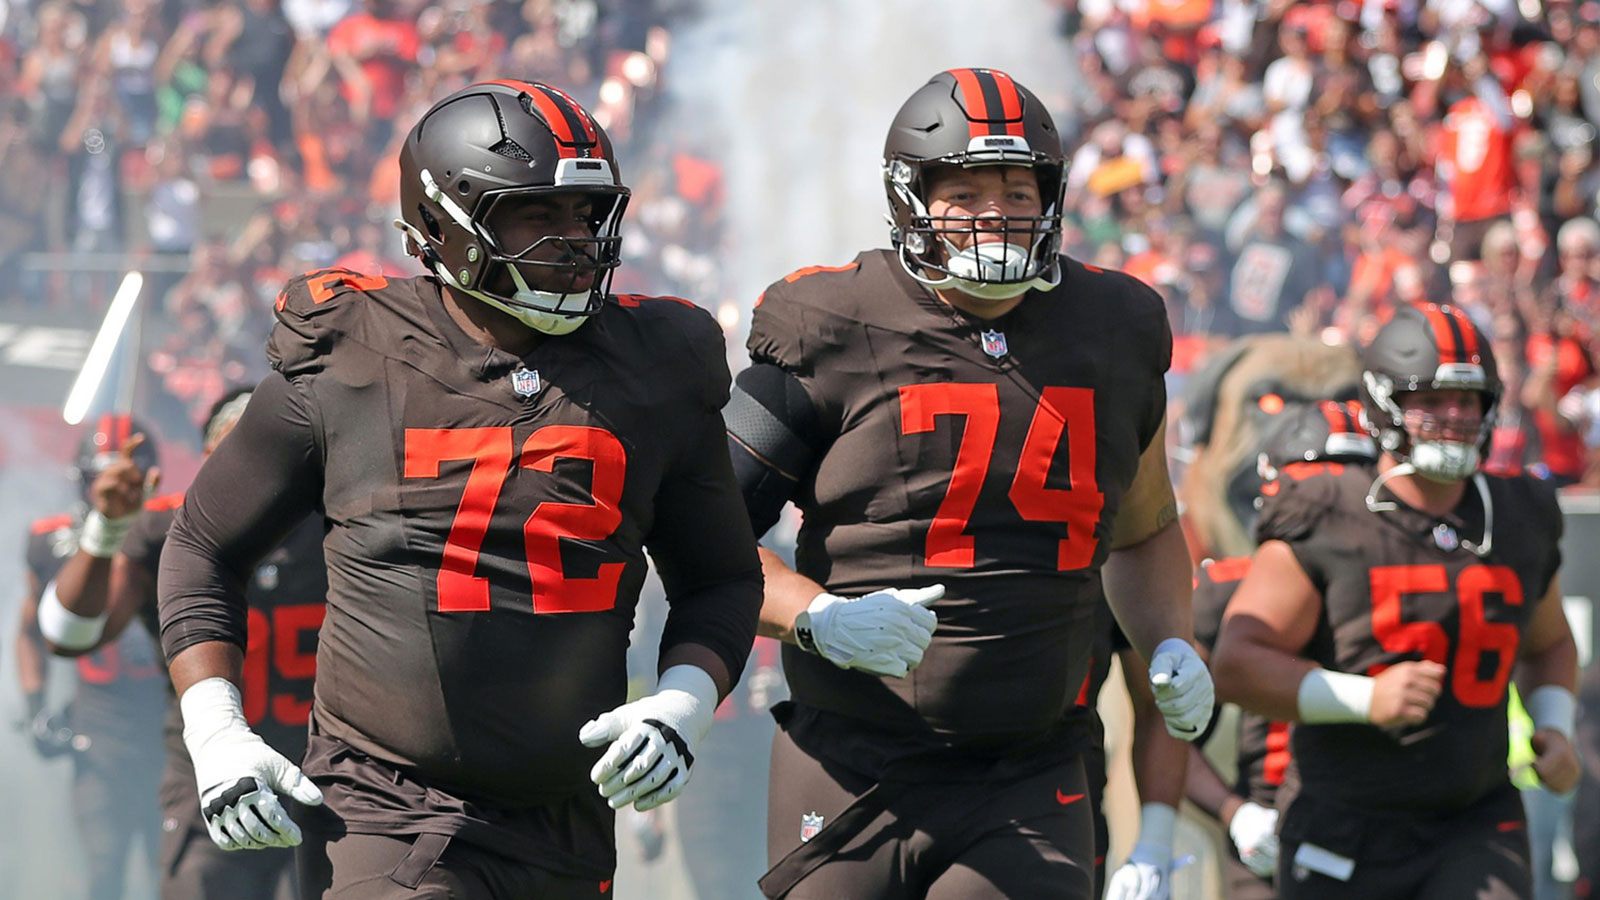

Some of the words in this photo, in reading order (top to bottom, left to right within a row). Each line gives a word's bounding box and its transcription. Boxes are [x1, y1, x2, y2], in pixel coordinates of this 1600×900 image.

[404, 426, 626, 613] 72
[899, 383, 1105, 571] 74
[1366, 563, 1524, 708] 56
